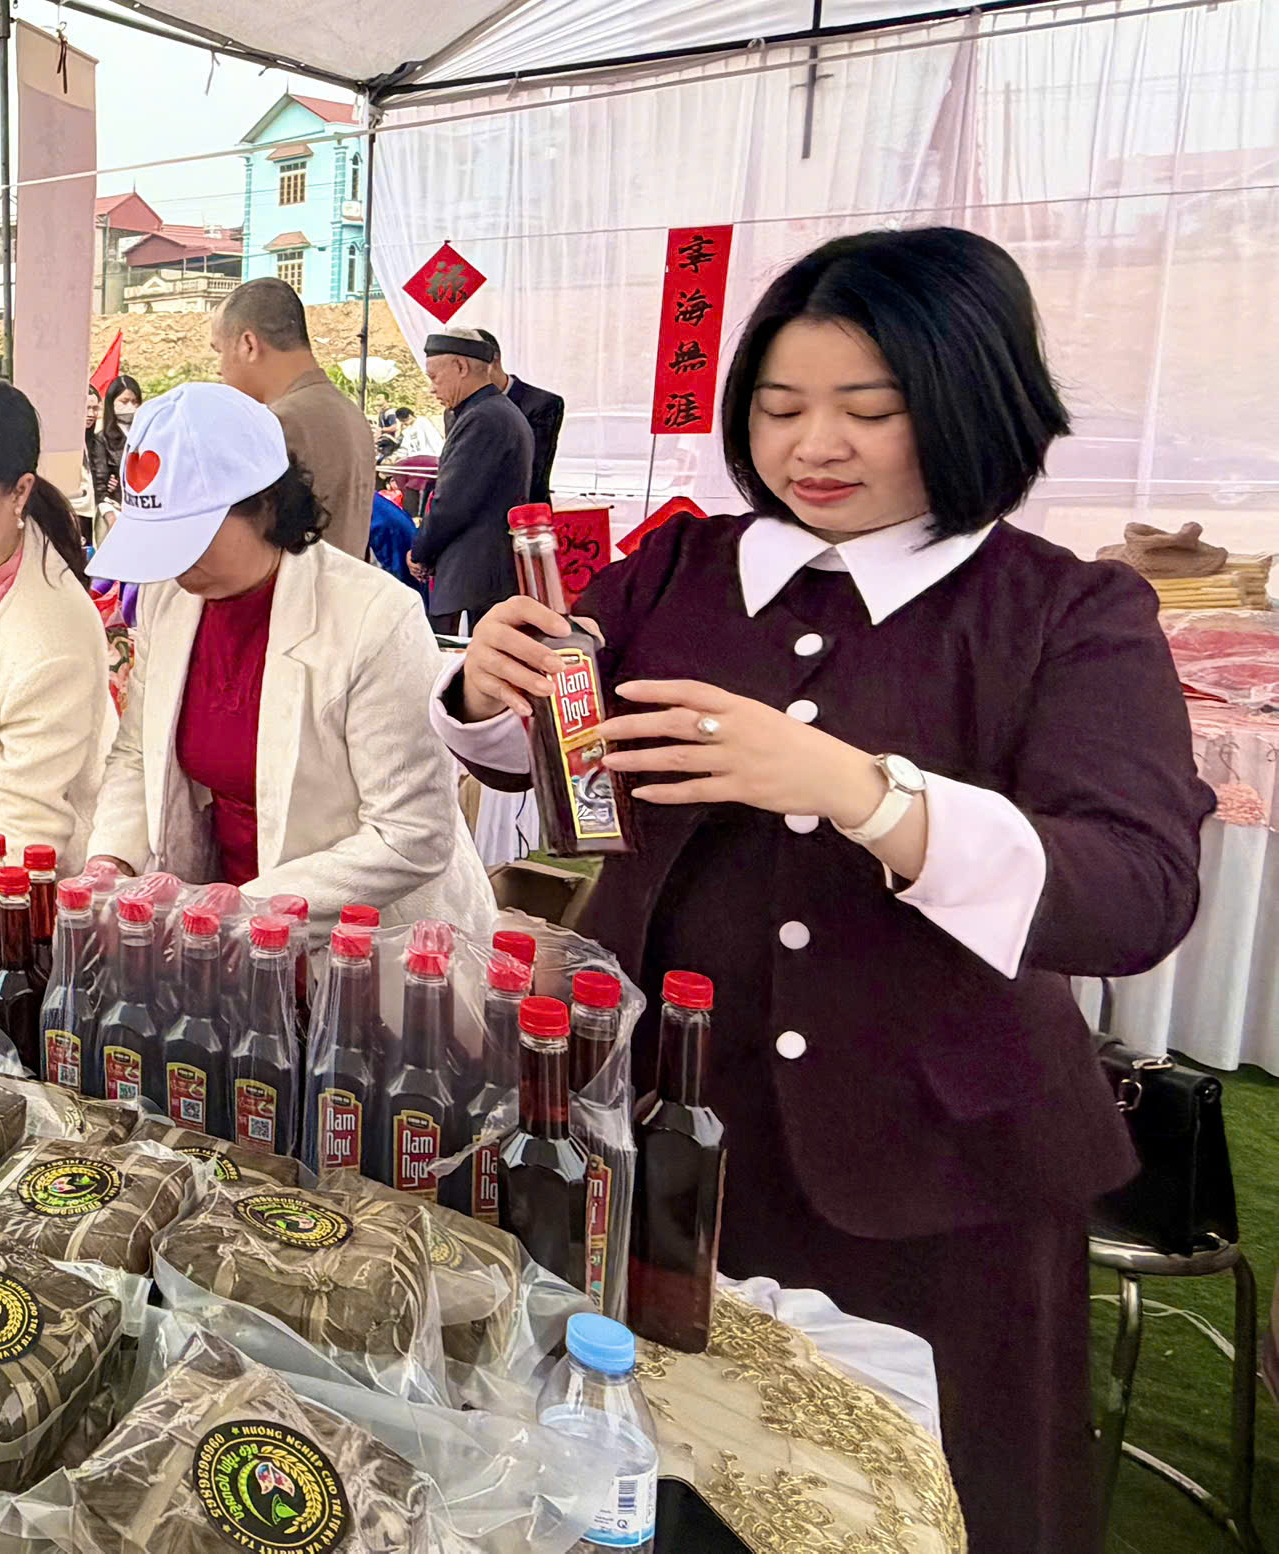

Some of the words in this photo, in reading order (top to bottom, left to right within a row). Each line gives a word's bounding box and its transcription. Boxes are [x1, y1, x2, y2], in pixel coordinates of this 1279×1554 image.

[557, 671, 589, 696] Nam
[561, 694, 590, 732] Ngư
[326, 1108, 356, 1131] Nam
[326, 1132, 352, 1164] Ngư
[402, 1130, 434, 1154] Nam
[481, 1149, 498, 1174] Na
[481, 1176, 498, 1209] Ng
[322, 1470, 337, 1494] CHO
